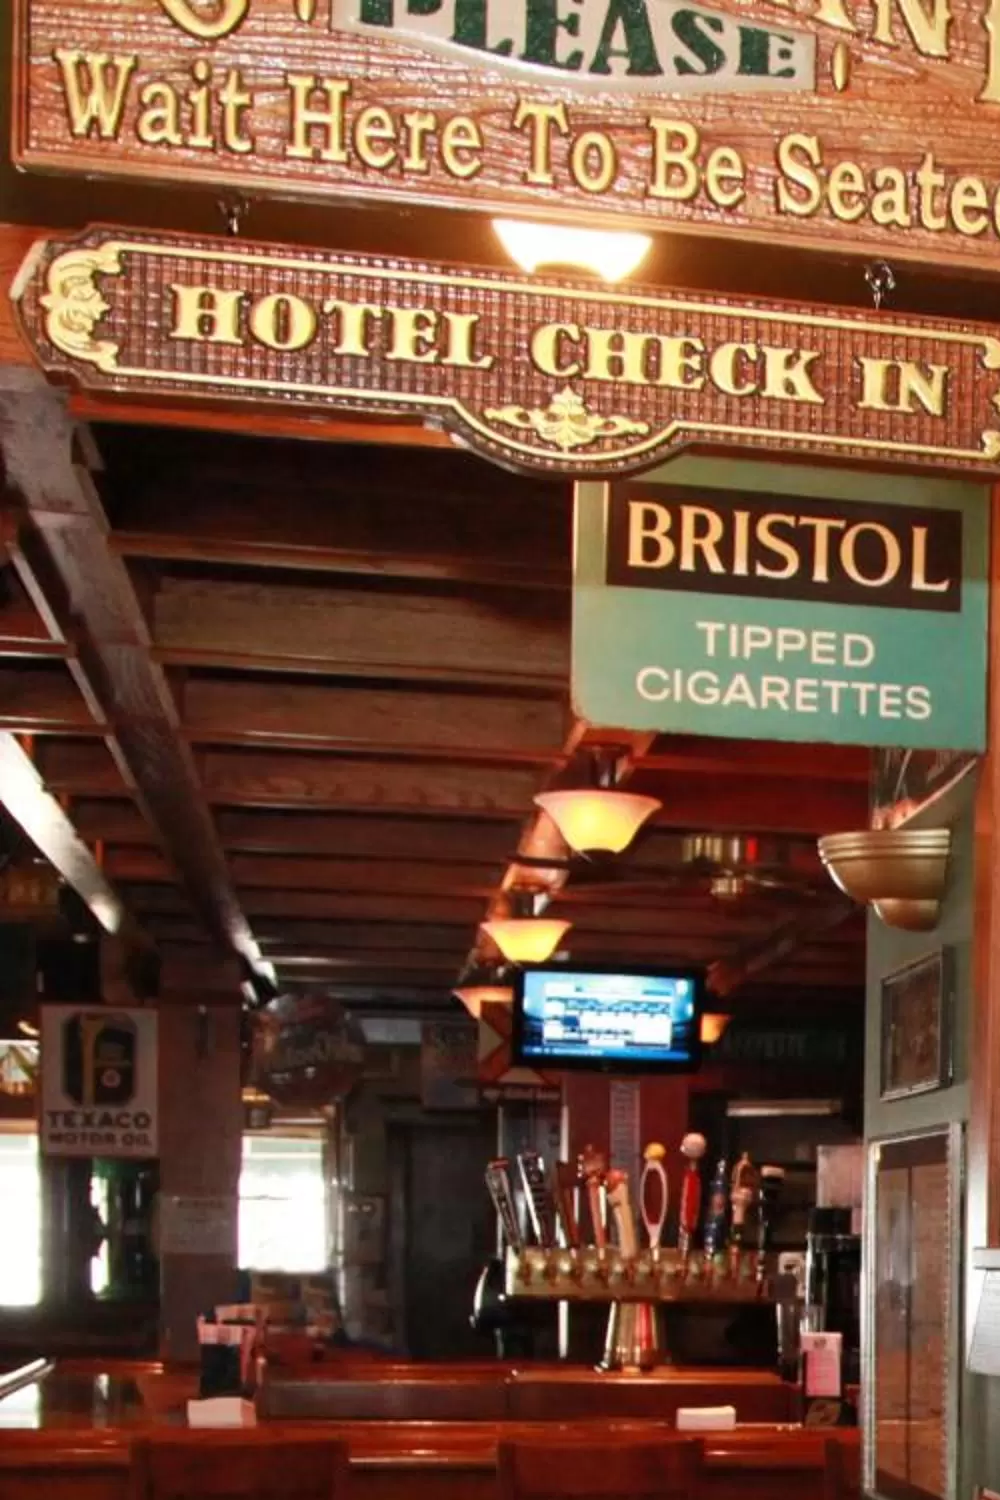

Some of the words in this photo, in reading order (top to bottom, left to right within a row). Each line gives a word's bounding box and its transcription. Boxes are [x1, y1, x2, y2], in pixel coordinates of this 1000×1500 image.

[53, 48, 253, 154] Wait
[285, 73, 484, 178] Here
[512, 99, 618, 192] To
[648, 117, 746, 207] Be
[169, 282, 494, 369] HOTEL
[530, 322, 825, 403] CHECK
[856, 354, 950, 417] IN
[626, 499, 951, 593] BRISTOL
[695, 620, 876, 668] TIPPED
[635, 665, 932, 720] CIGARETTES
[46, 1110, 152, 1130] TEXACO
[48, 1131, 117, 1146] MOTOR
